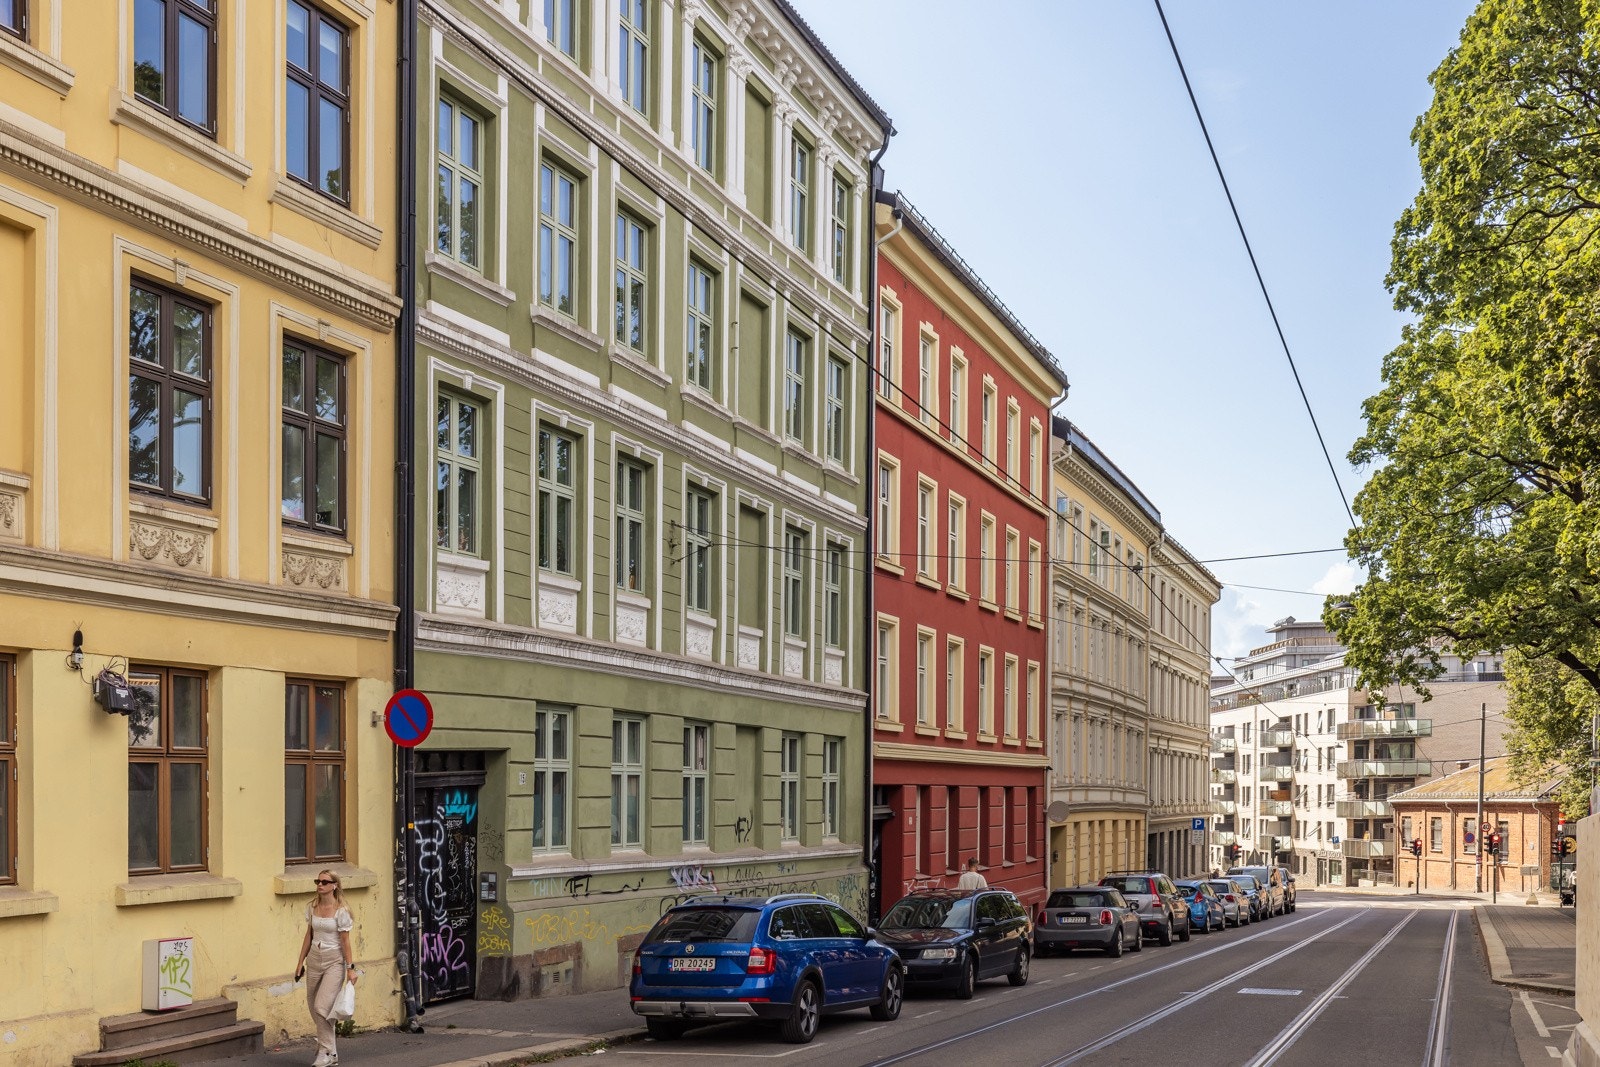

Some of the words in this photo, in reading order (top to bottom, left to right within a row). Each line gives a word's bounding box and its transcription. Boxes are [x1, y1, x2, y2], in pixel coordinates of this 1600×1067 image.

[1195, 820, 1202, 829] P
[673, 959, 684, 968] DR
[688, 959, 714, 968] 20245
